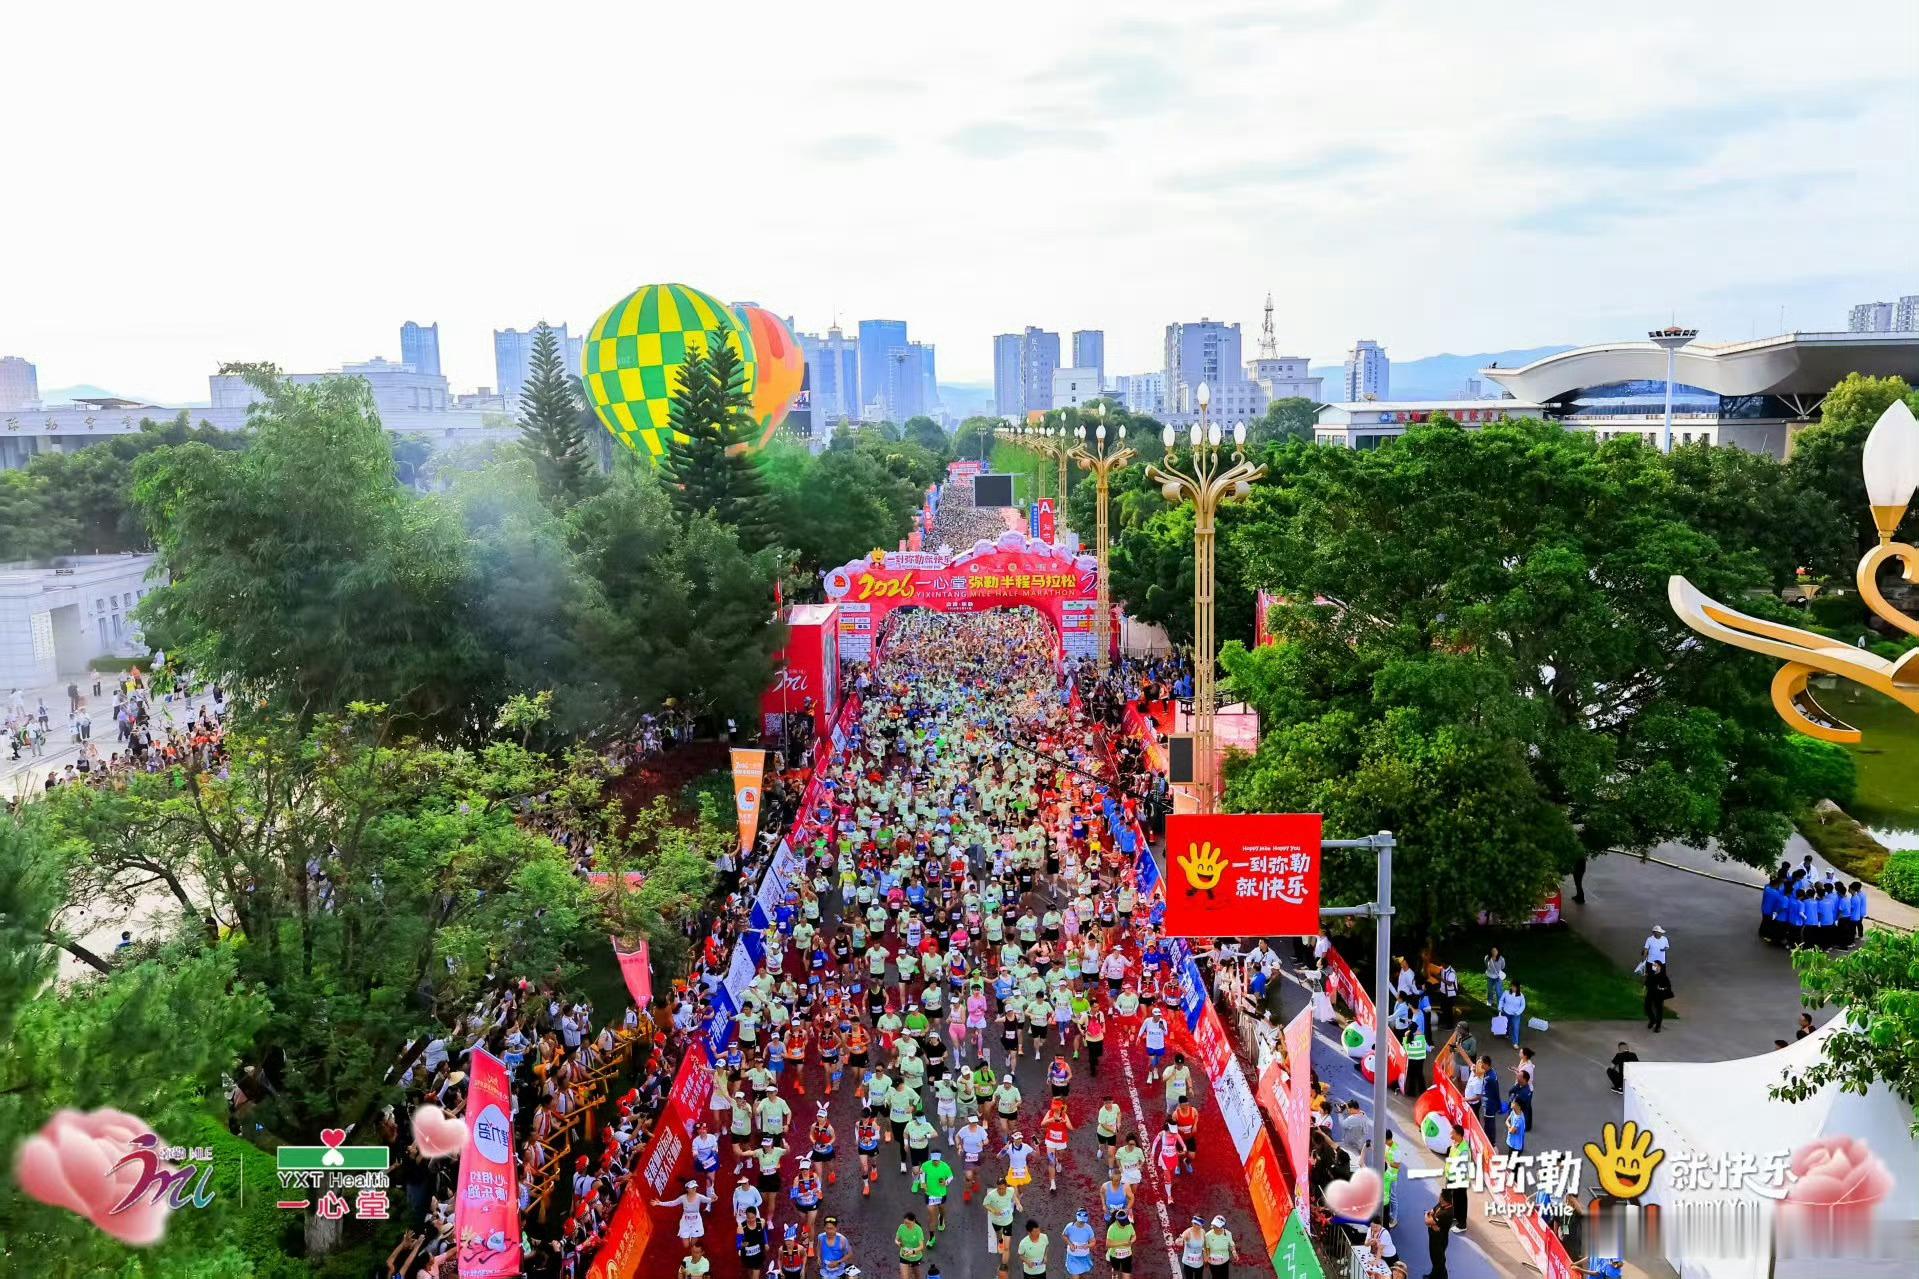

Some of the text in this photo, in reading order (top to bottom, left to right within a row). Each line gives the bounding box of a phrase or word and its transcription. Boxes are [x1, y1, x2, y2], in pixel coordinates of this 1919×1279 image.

[858, 571, 915, 600] 2026
[916, 576, 967, 589] 一心堂
[969, 574, 1076, 588] 弥勒半程马拉松
[1232, 853, 1311, 875] 一到弥勒
[1236, 875, 1309, 904] 就快乐
